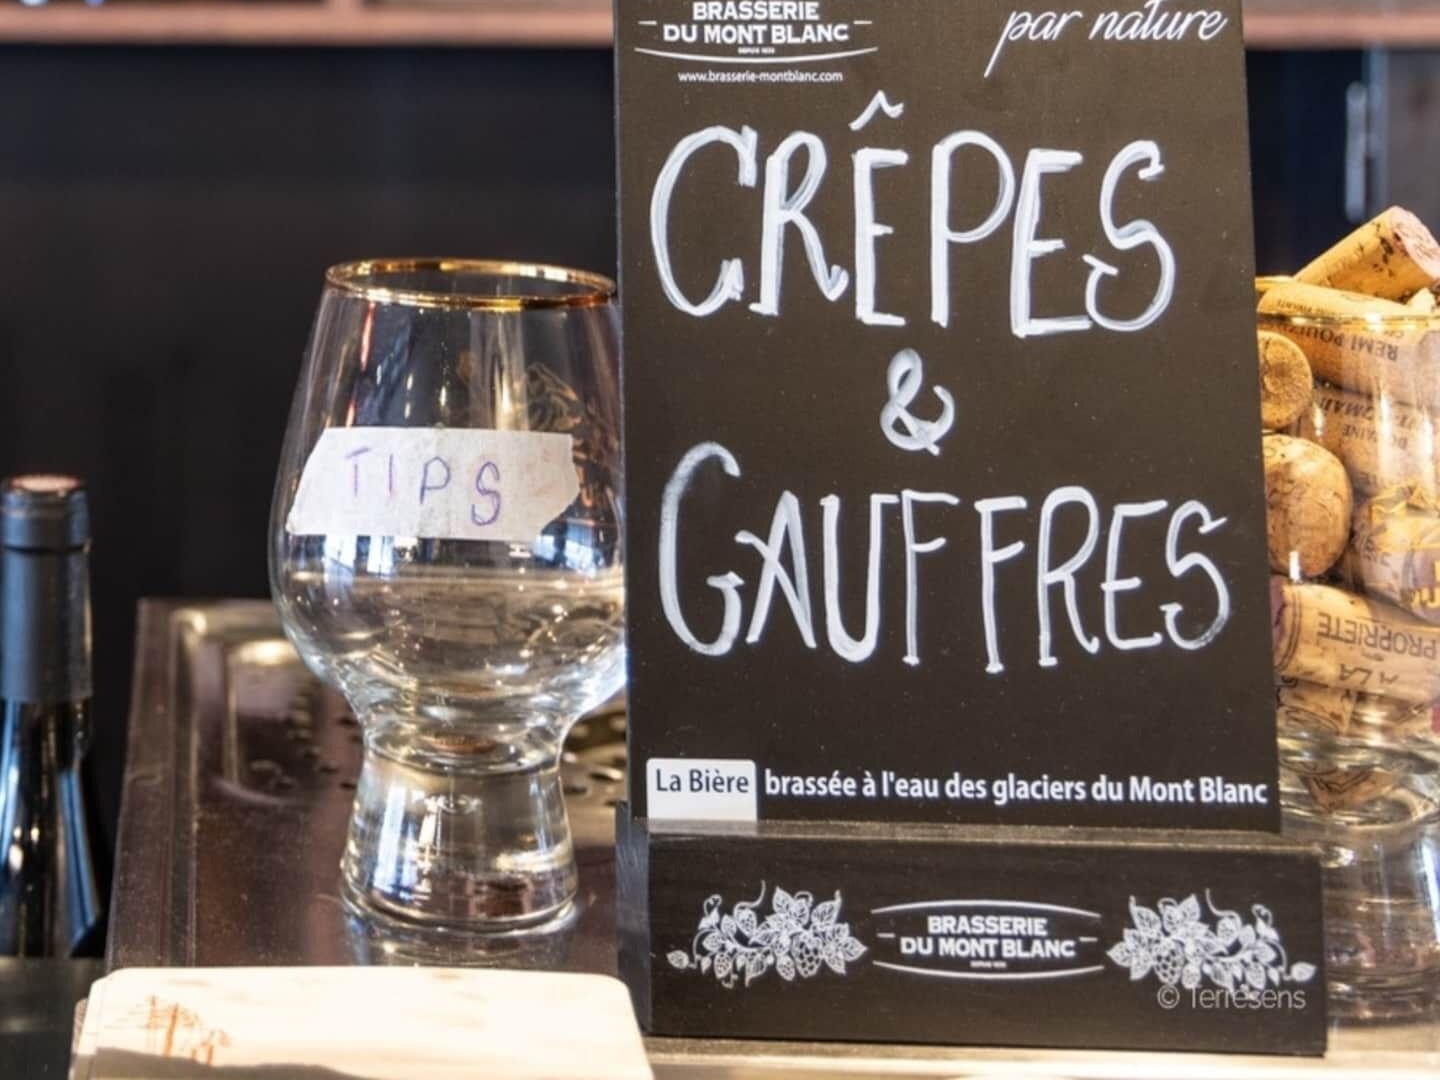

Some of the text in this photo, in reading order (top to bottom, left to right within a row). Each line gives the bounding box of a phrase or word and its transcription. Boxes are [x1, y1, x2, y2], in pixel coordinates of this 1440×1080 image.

[693, 0, 820, 20] BRASSERIE
[663, 24, 849, 44] DU MONT BLANC
[984, 10, 1083, 78] par
[678, 70, 843, 82] www.brasserie-montblanc.com
[650, 91, 1175, 338] CRÊPES
[881, 350, 954, 456] &
[345, 446, 502, 526] TIPS
[1316, 610, 1438, 661] PROPRIETE
[656, 769, 1267, 805] La Bière brassée à l'eau des glaciers du Mont Blanc
[928, 916, 1048, 936] BRASSERIE
[901, 937, 1075, 958] DU MONT BLANC
